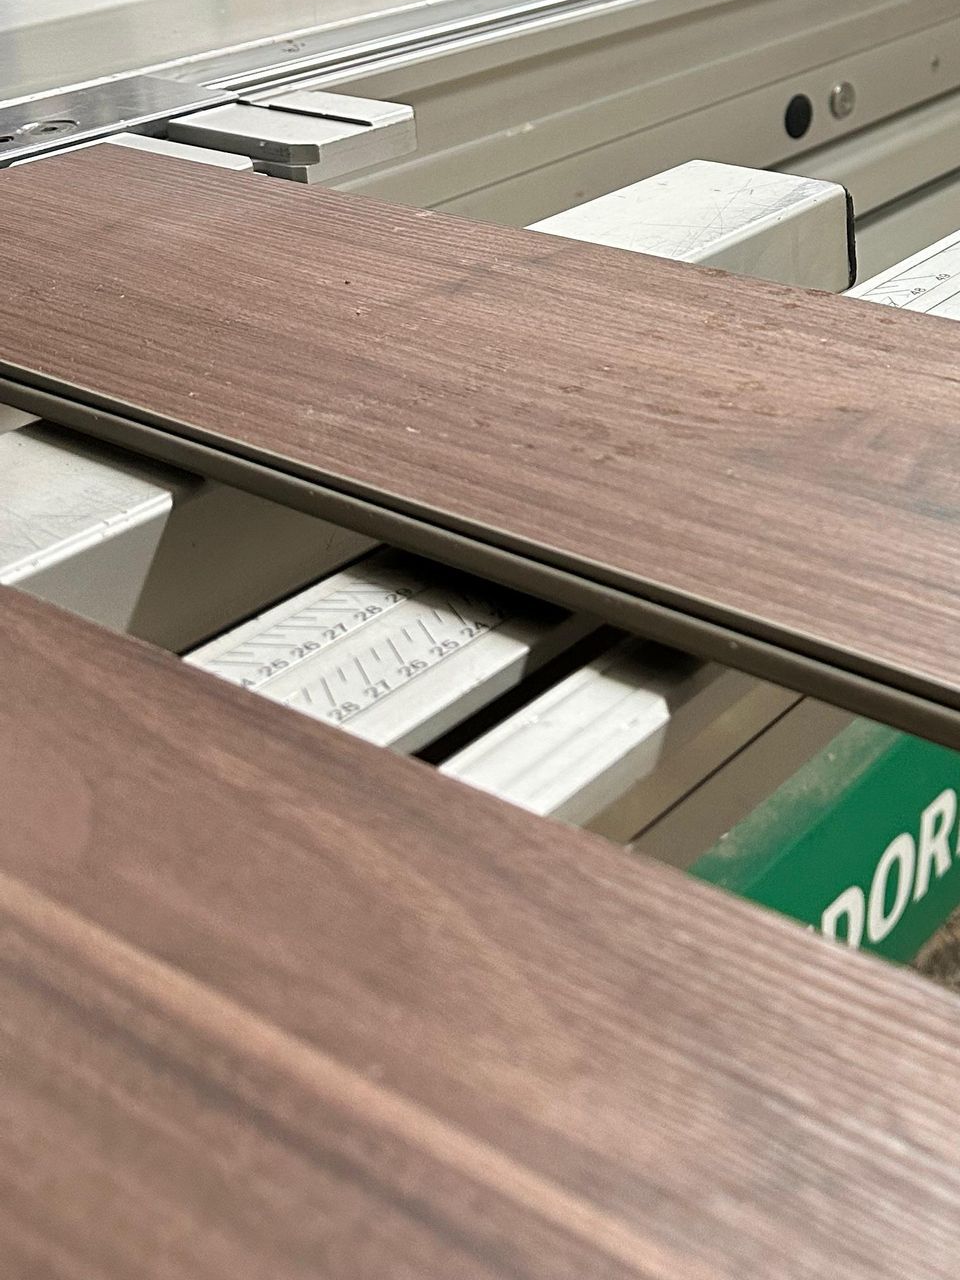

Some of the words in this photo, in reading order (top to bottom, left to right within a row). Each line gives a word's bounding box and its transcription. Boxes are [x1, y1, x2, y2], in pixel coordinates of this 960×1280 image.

[910, 287, 927, 296] 48
[935, 273, 951, 281] 49
[258, 658, 290, 677] 25
[290, 640, 322, 659] 26
[322, 622, 348, 641] 27
[353, 604, 384, 622] 28
[385, 587, 413, 604] 29
[326, 700, 361, 722] 28
[363, 678, 391, 699] 27
[397, 658, 429, 678] 26
[429, 638, 460, 658] 25
[460, 620, 491, 639] 24
